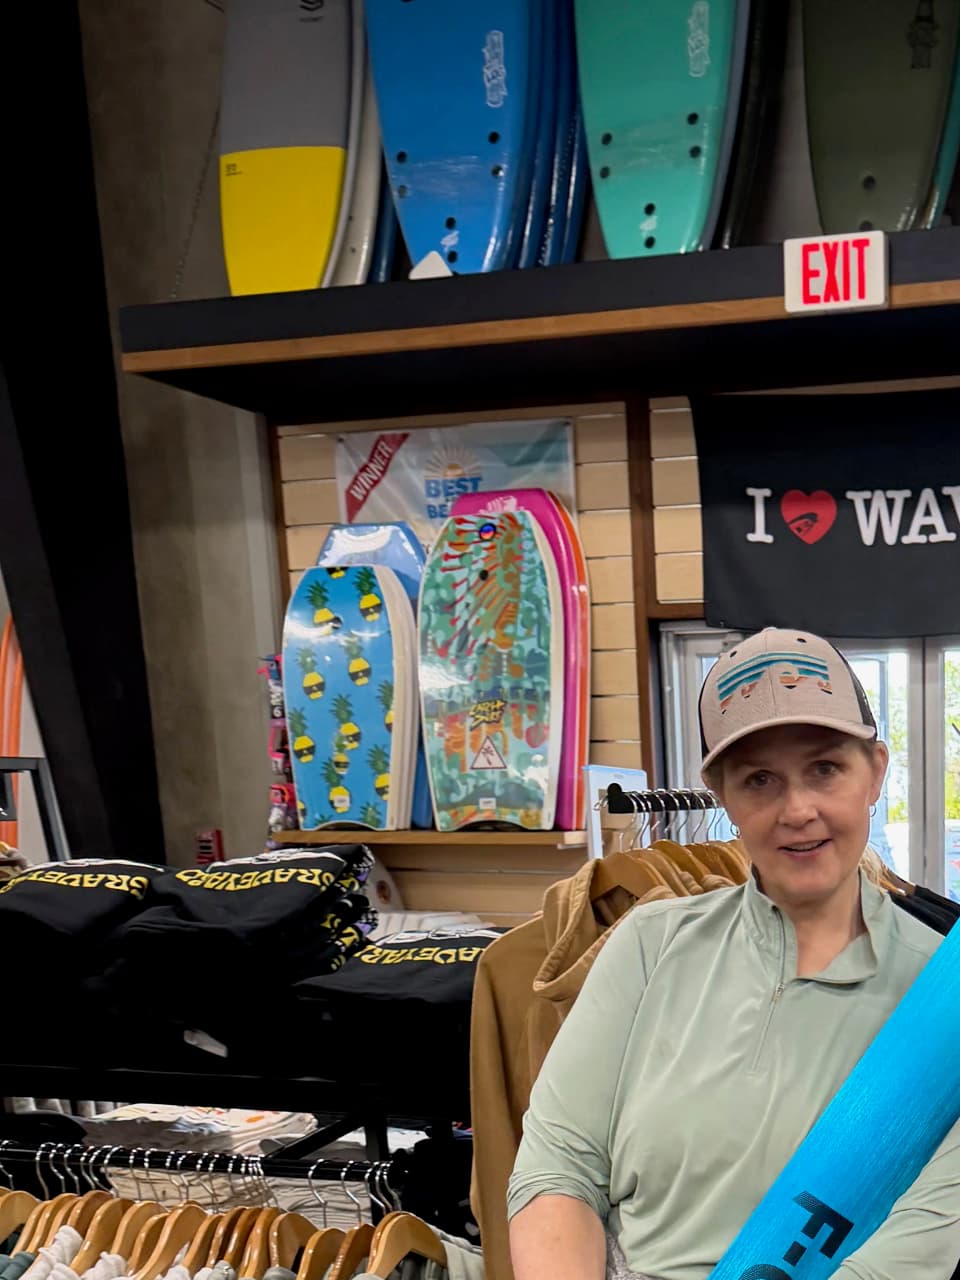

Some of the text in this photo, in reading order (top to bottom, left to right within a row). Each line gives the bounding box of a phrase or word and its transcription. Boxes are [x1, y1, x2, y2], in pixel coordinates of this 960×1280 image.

[802, 238, 870, 305] EXIT
[350, 441, 393, 501] WINNER
[425, 476, 482, 497] BEST
[427, 504, 449, 519] BE
[746, 487, 774, 544] I
[353, 945, 485, 965] AVEYAR
